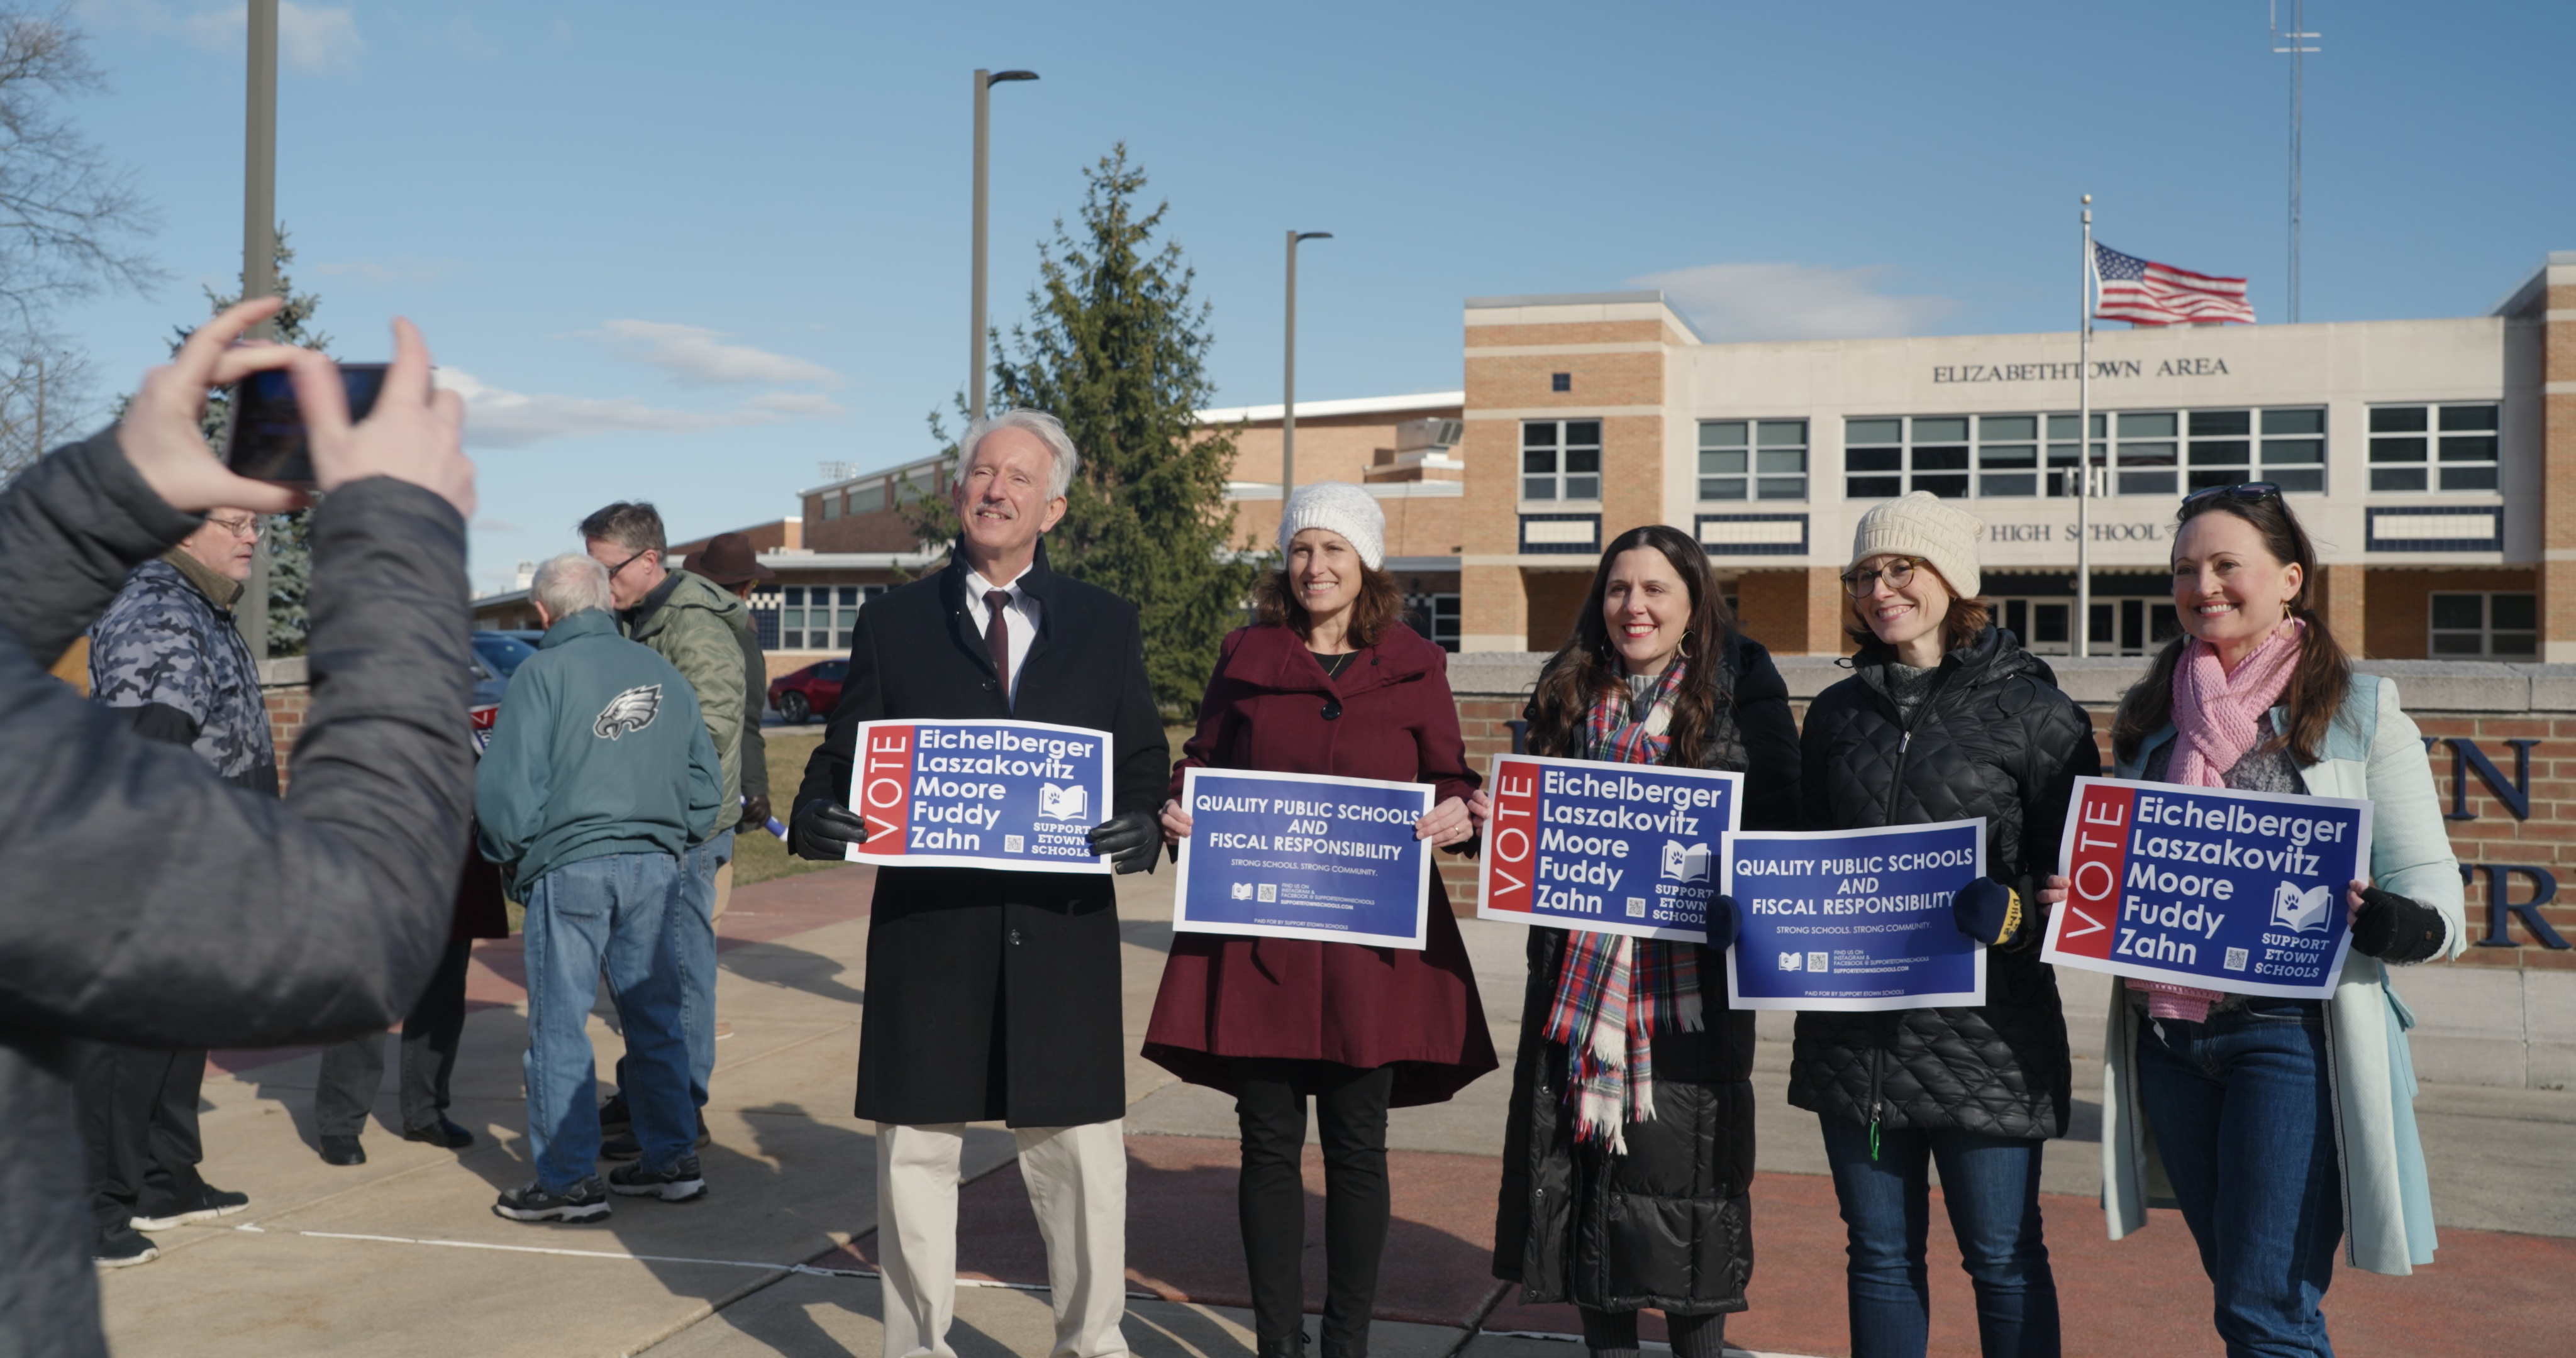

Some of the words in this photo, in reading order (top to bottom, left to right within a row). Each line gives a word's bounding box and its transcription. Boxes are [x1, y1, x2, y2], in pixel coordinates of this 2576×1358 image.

[1933, 360, 2141, 383] ELIZABETHTOWN
[2158, 358, 2228, 376] AREA
[1991, 525, 2050, 541] HIGH
[2065, 522, 2162, 542] SHOOL
[919, 729, 1094, 758] Eichelberger
[918, 753, 1074, 779] Laszakovitz
[865, 735, 906, 843] VOTE
[914, 776, 1006, 800] Moore
[1545, 771, 1721, 810] Eichelberger
[914, 801, 1001, 830] Fuddy
[1197, 795, 1269, 813] QUALITY
[1274, 800, 1333, 817] PUBLIC
[1338, 804, 1420, 825] SCHOOLS
[1543, 799, 1699, 836] Laszakovitz
[2138, 797, 2347, 846] Eichelberger
[911, 827, 979, 850] Zahn
[1033, 822, 1091, 834] SUPPORT
[1038, 834, 1085, 846] ETOWN
[1287, 819, 1327, 835] AND
[1494, 775, 1531, 897] VOTE
[1031, 845, 1090, 857] SCHOOLS
[1210, 833, 1268, 849] FISCAL
[1274, 836, 1401, 860] RESPONSIBILITY
[1540, 828, 1629, 858] Moore
[2133, 829, 2319, 876] Laszakovitz
[1262, 861, 1299, 869] SCHOOLS.
[1301, 863, 1330, 871] STRONG
[1331, 865, 1378, 876] COMMUNITY.
[1540, 856, 1623, 891] Fuddy
[1736, 859, 1815, 876] QUALITY
[1822, 856, 1882, 875] PUBLIC
[1889, 848, 1972, 871] SCHOOLS
[2066, 801, 2124, 938] VOTE
[1655, 884, 1714, 898] SUPPORT
[1837, 878, 1879, 895] AND
[2127, 863, 2233, 900] Moore
[1536, 885, 1602, 914] Zahn
[1660, 897, 1707, 911] ETOWN
[1753, 899, 1816, 915] FISCAL
[1823, 892, 1956, 915] RESPONSIBILITY
[1653, 910, 1706, 924] SCHOOL
[1853, 925, 1884, 934] STRONG
[1885, 921, 1932, 932] COMMUNITY.
[2124, 895, 2224, 939] Fuddy
[2116, 928, 2196, 964] Zahn
[2262, 933, 2329, 949] SUPPORT
[2265, 949, 2319, 963] ETOWN
[2255, 963, 2319, 977] SCHOOLS
